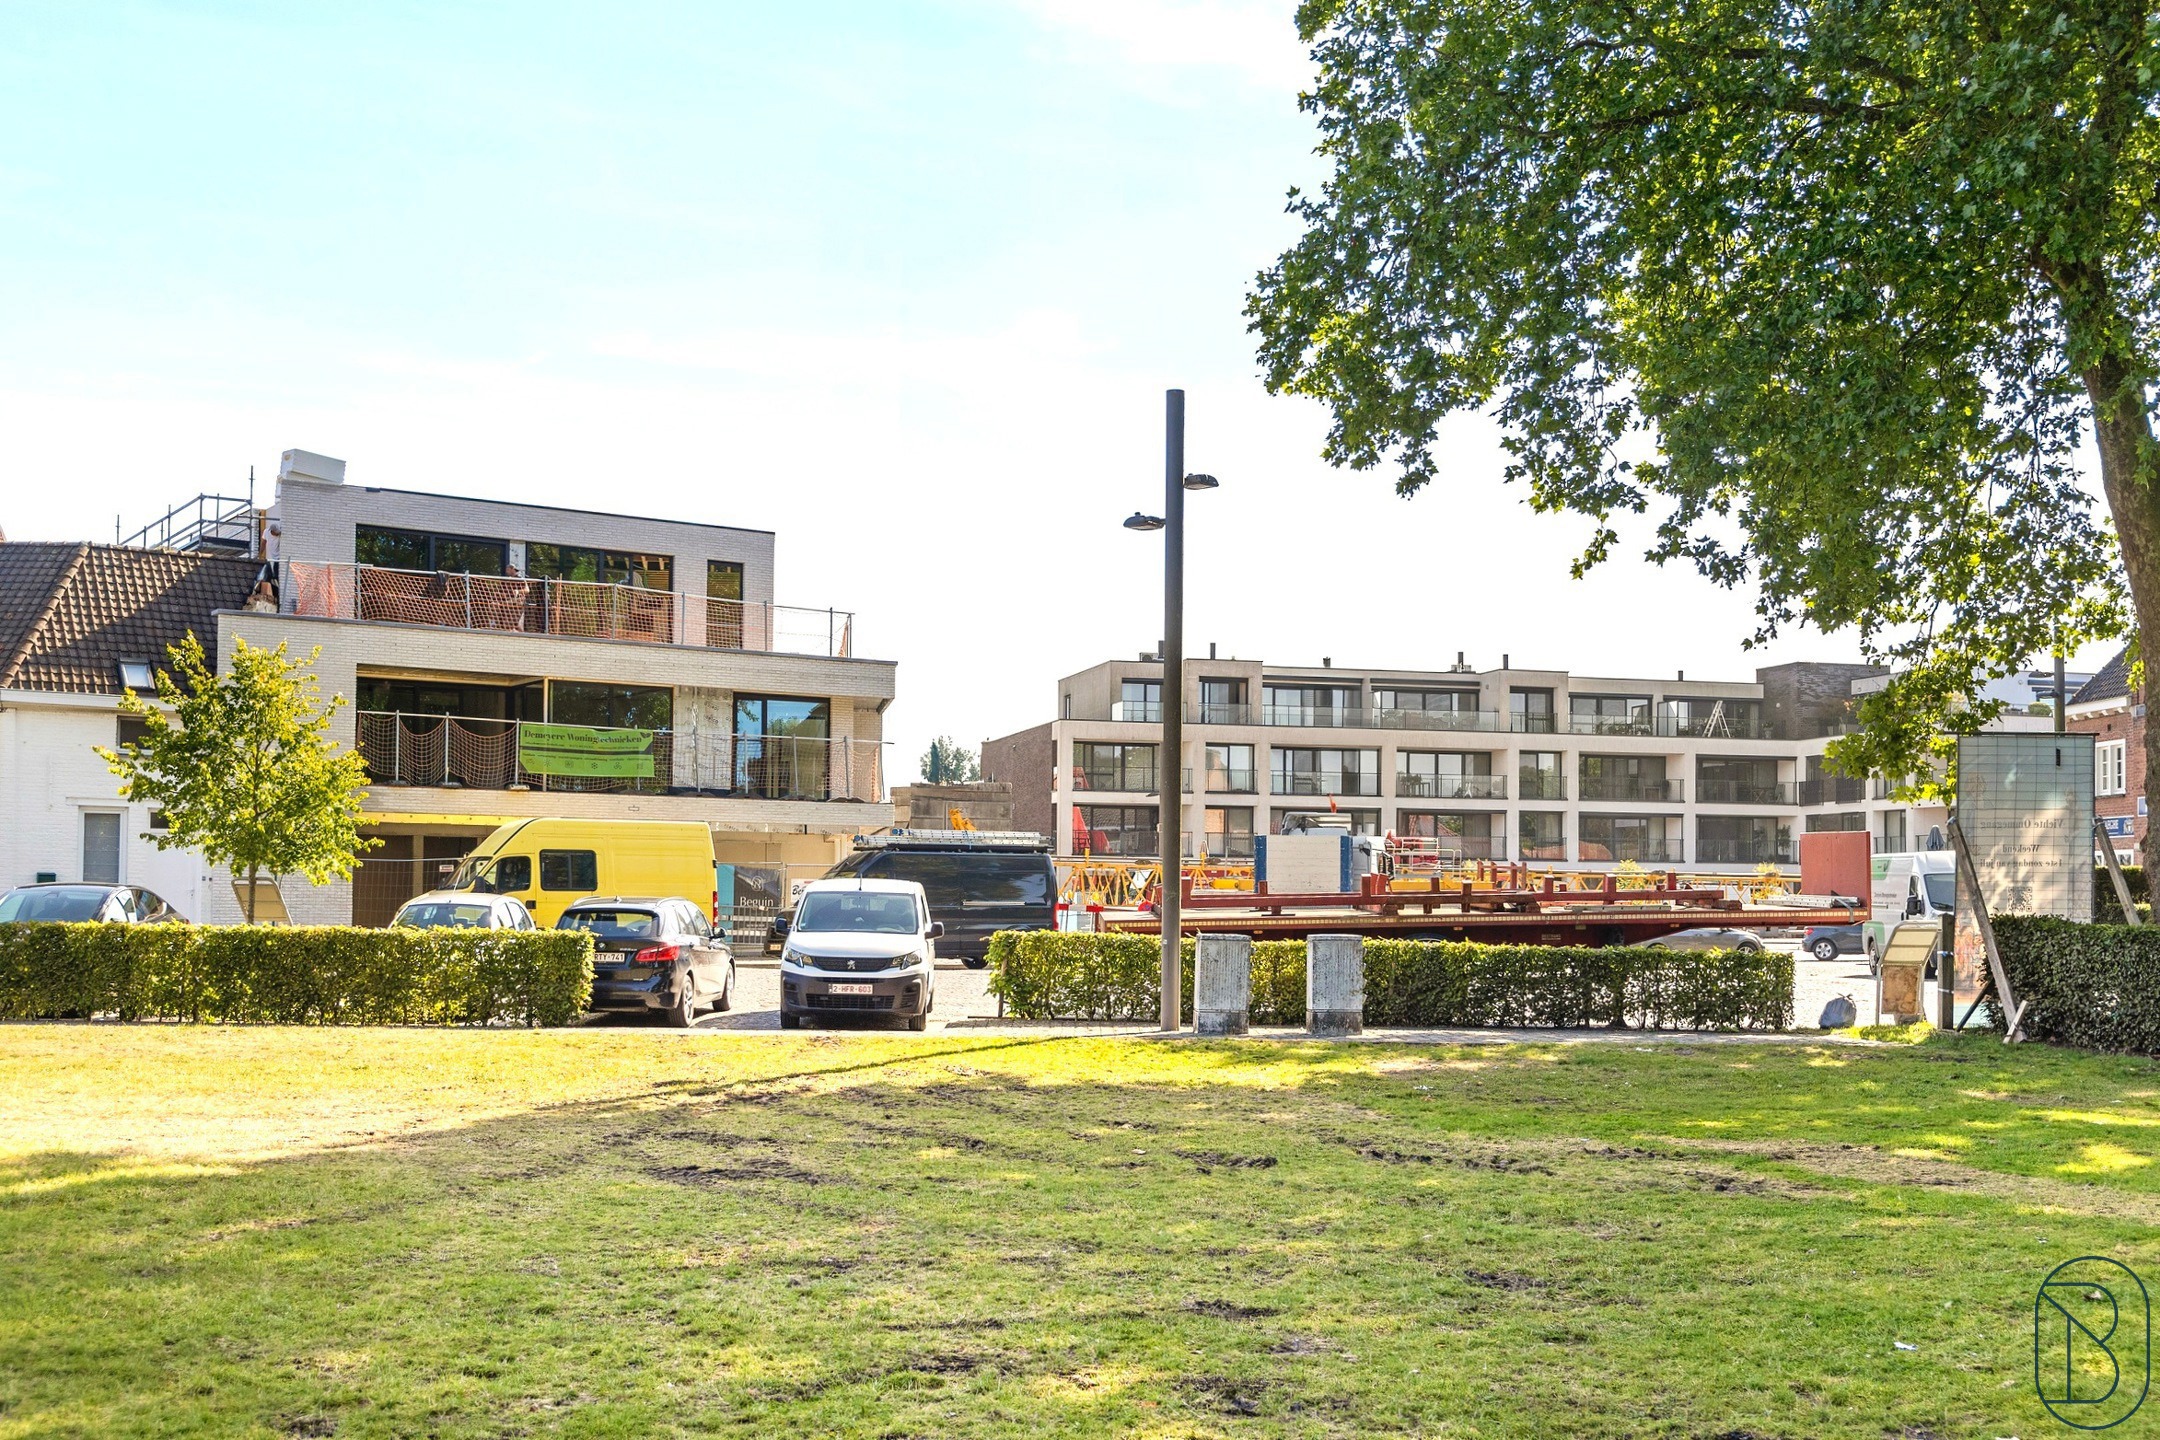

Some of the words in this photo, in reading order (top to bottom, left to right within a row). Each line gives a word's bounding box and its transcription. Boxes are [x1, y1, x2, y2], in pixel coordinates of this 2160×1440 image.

[524, 730, 565, 741] Demeyere
[740, 896, 774, 909] Beguin
[833, 985, 872, 993] 2-HFR-603
